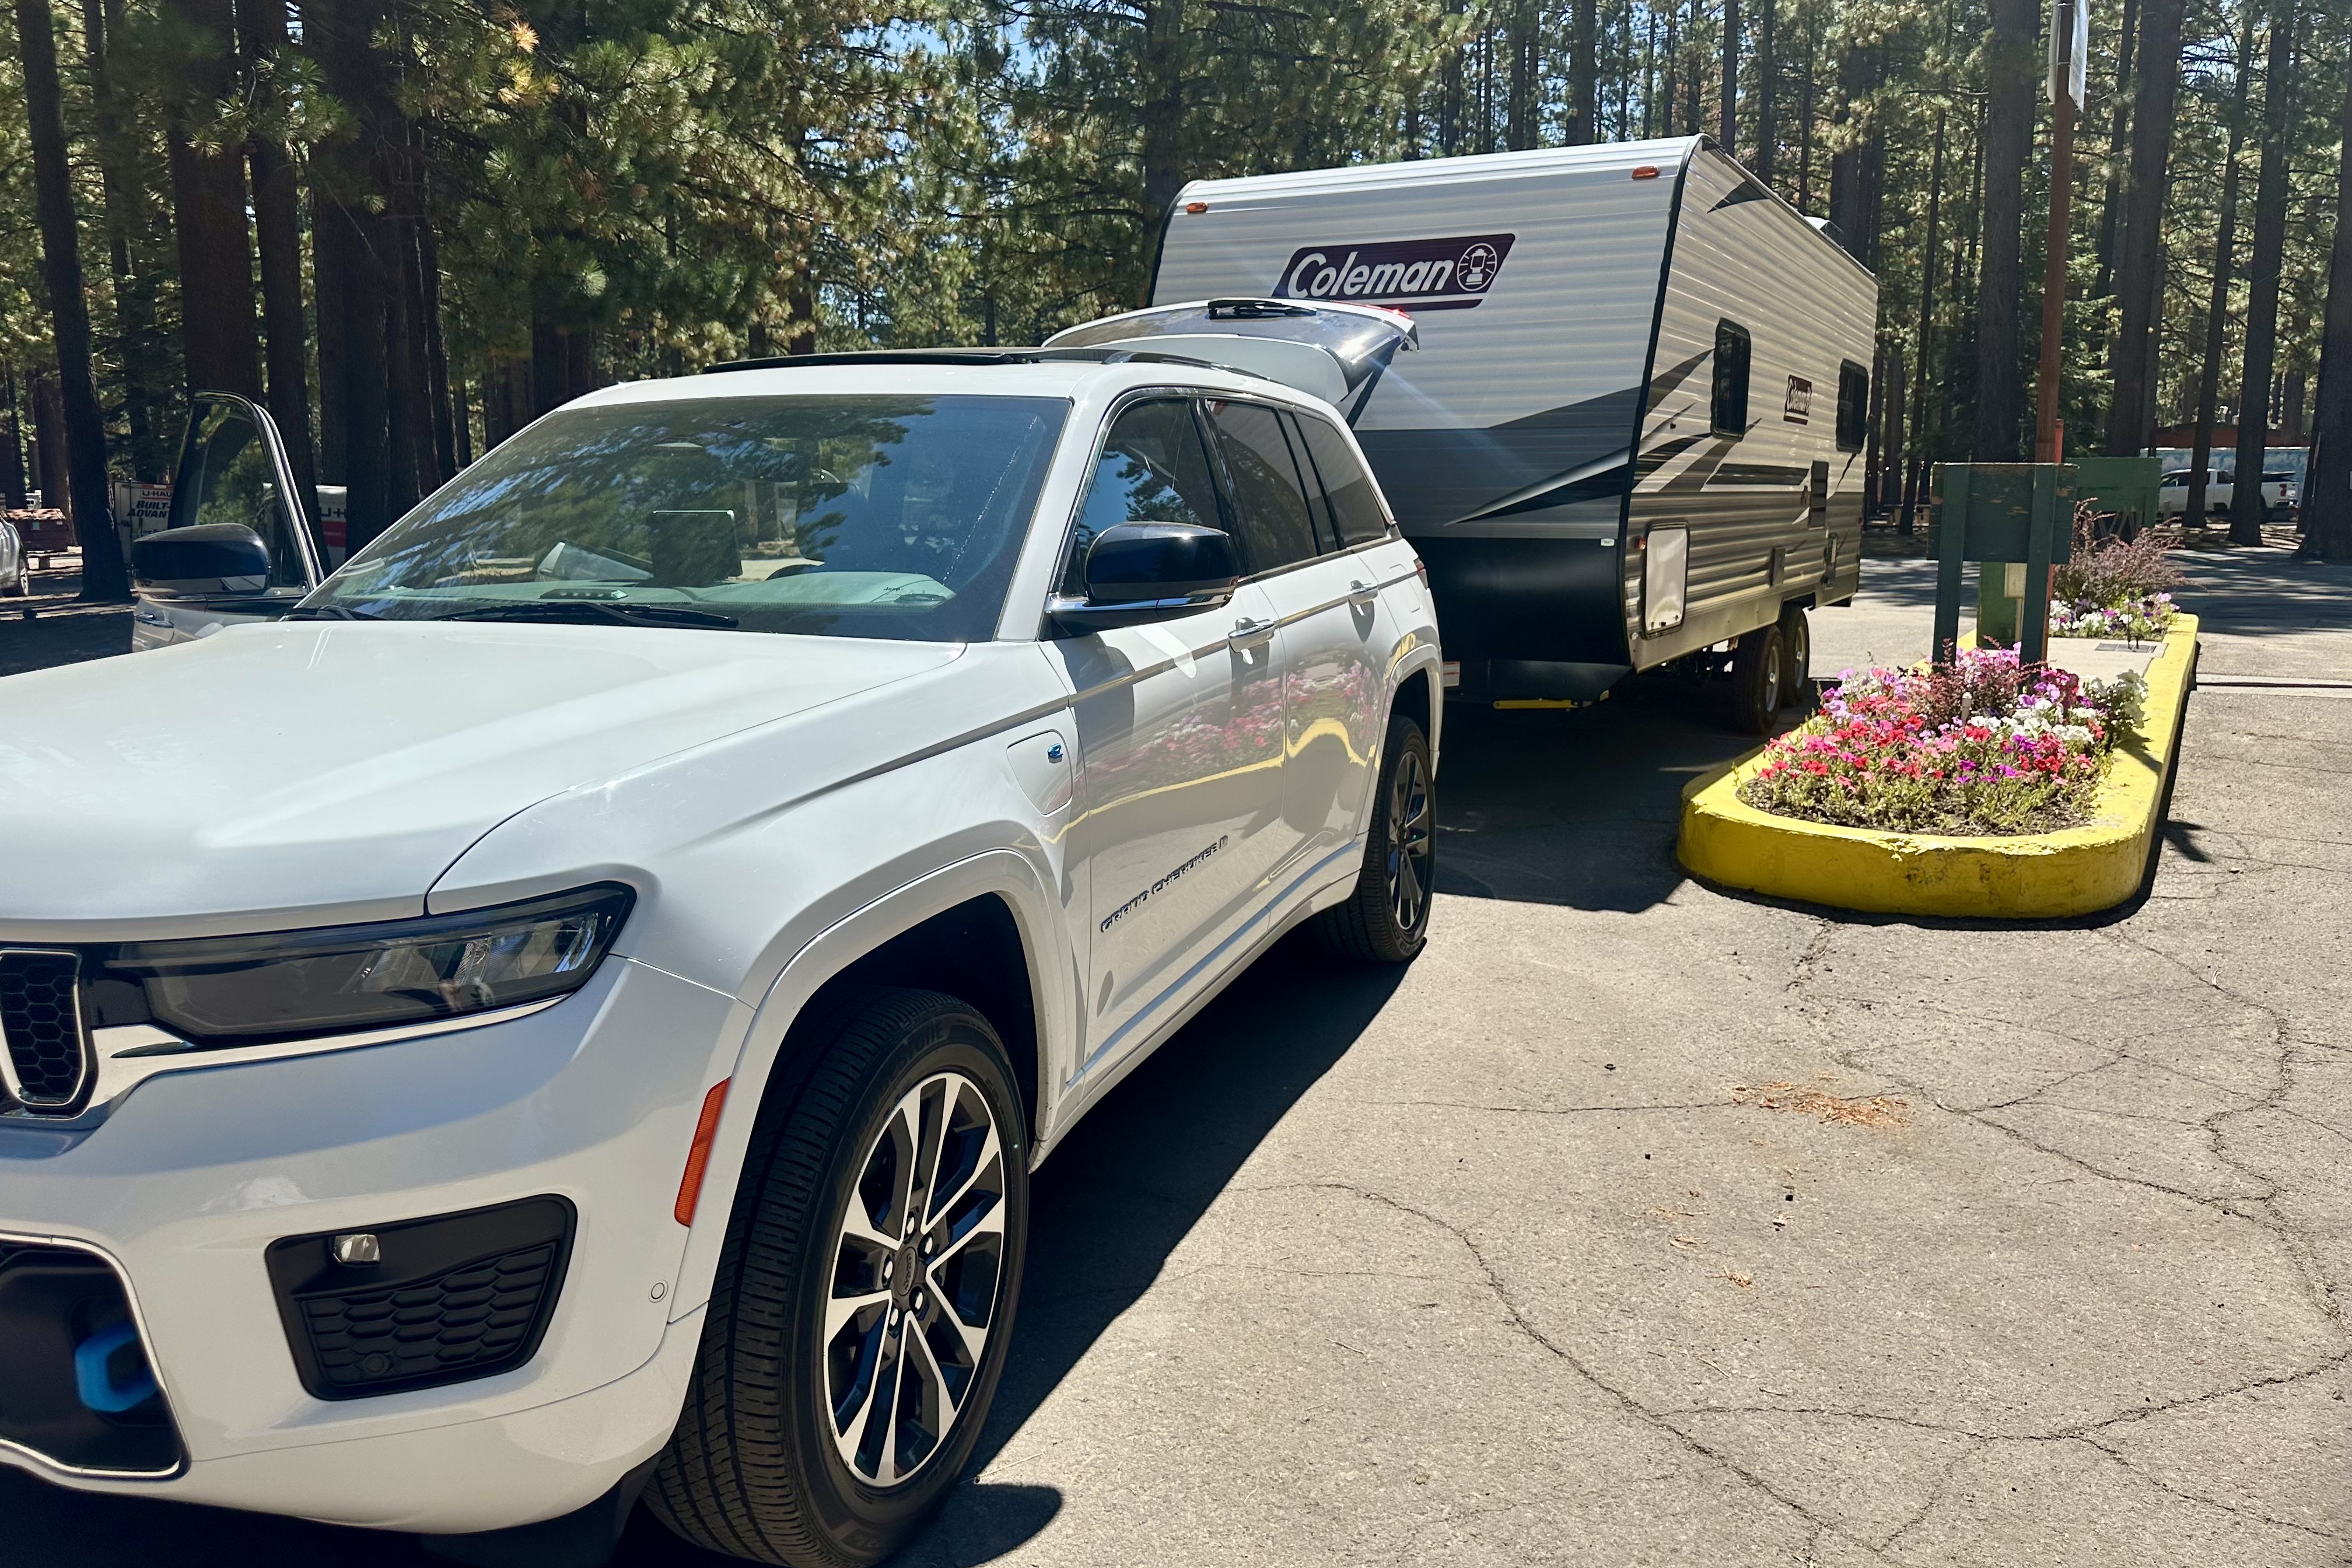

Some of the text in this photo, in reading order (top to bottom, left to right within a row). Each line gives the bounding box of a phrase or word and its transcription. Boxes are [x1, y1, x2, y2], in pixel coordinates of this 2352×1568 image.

[1287, 251, 1455, 298] Coleman
[127, 508, 168, 518] ADVAN
[1100, 842, 1218, 933] GRAND CHEROKEE
